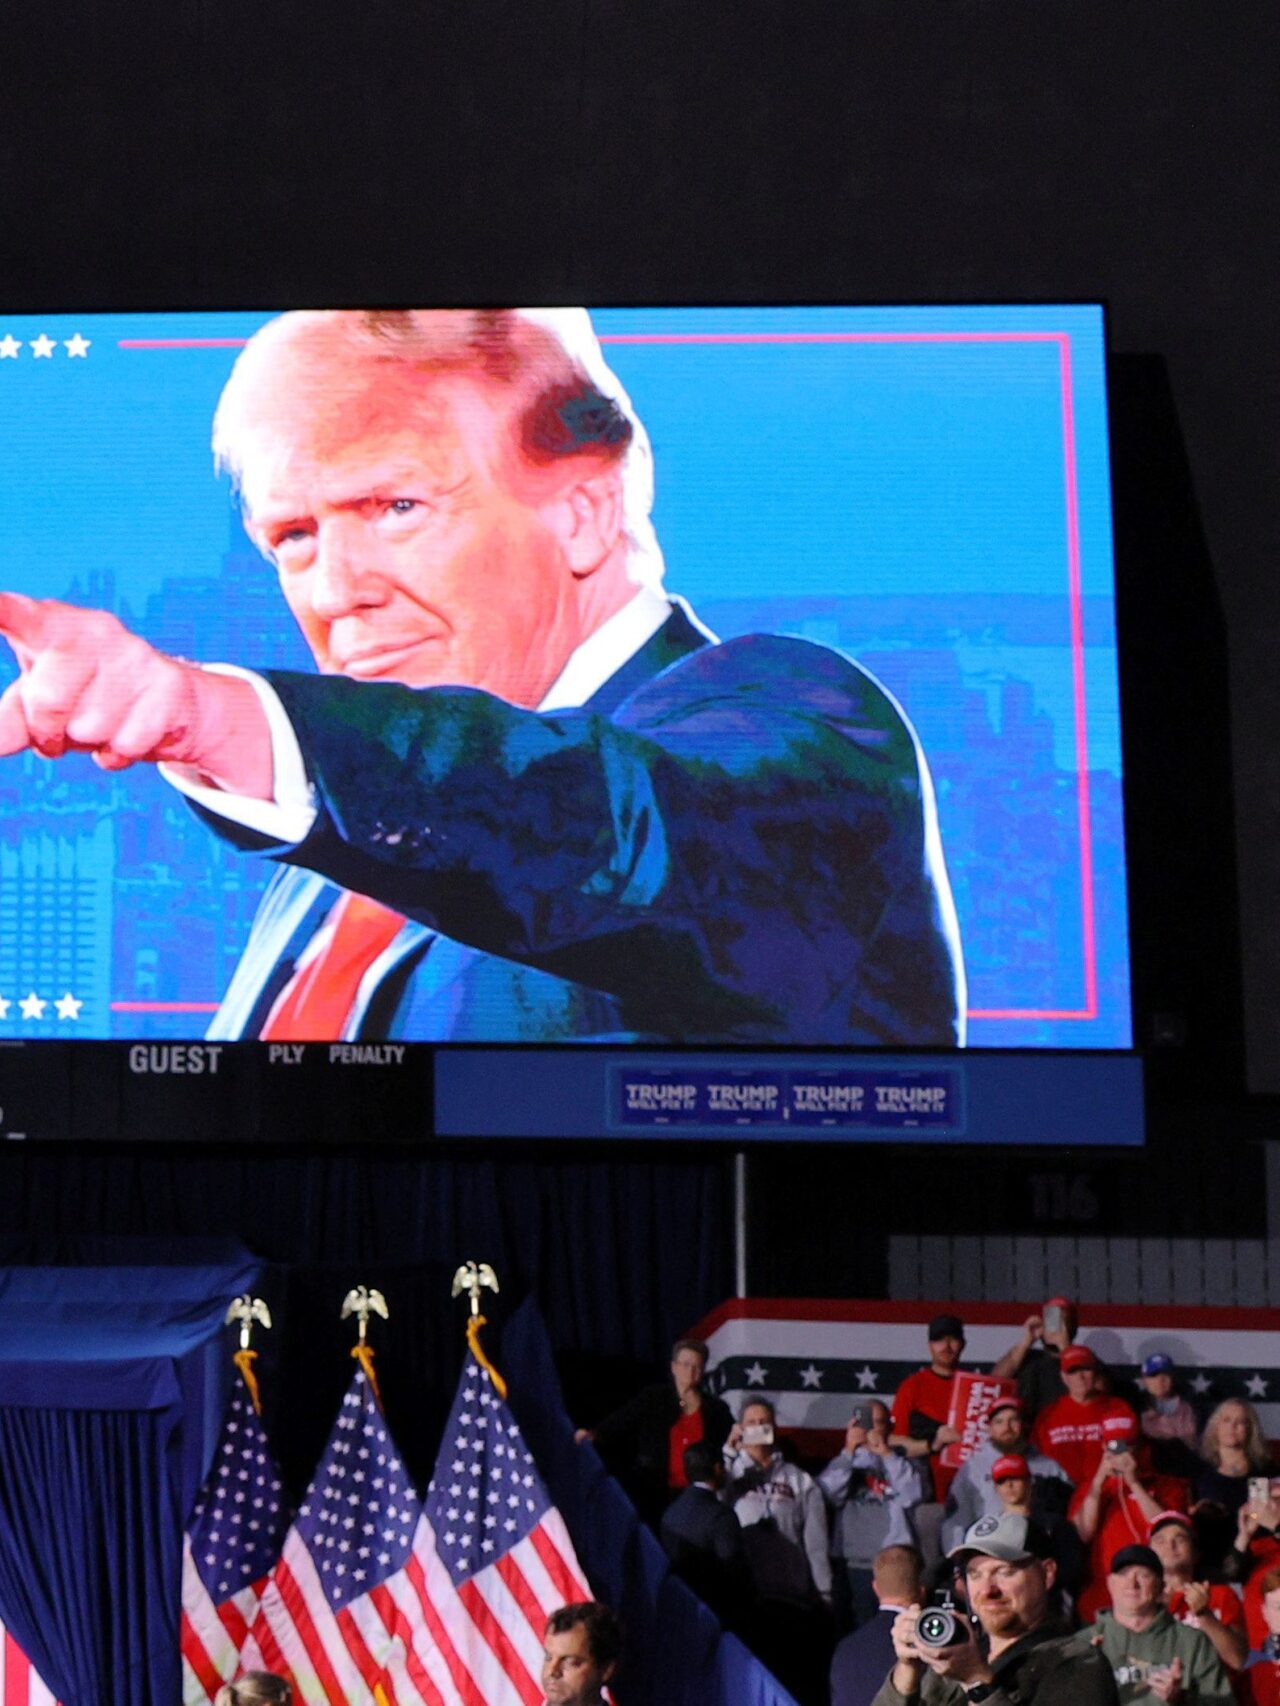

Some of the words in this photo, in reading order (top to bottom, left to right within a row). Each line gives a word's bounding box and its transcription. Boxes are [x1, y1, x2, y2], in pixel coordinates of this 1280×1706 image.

[129, 1045, 222, 1074] GUEST
[268, 1044, 305, 1064] PLY
[329, 1044, 405, 1065] PENALTY
[625, 1084, 697, 1100] TRUMP
[707, 1085, 779, 1101] TRUMP
[793, 1085, 865, 1102] TRUMP
[874, 1086, 946, 1103] TRUMP
